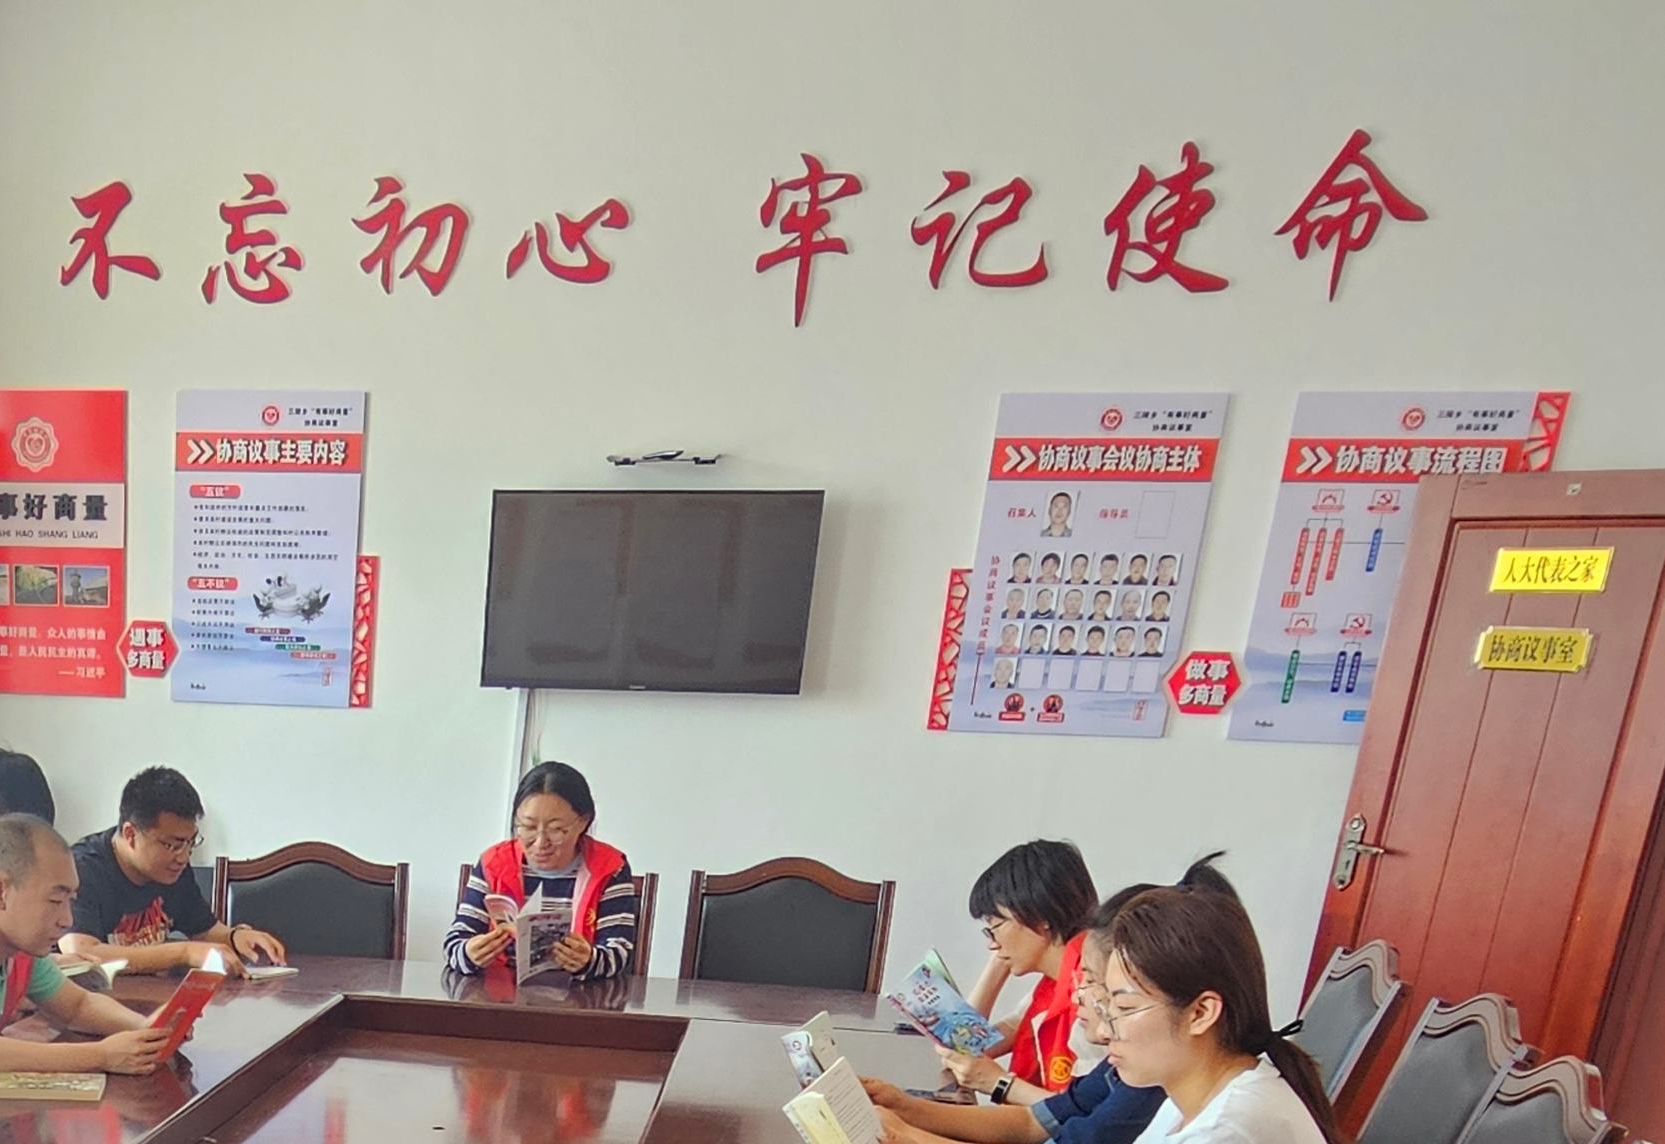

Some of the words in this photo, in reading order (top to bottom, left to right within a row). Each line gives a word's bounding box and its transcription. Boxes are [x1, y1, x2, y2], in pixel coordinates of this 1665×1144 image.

[59, 174, 631, 304] 不忘初心
[756, 130, 1427, 324] 牢记使命
[215, 438, 347, 466] 协商议事主要内容
[1038, 443, 1202, 473] 协商议事会议协商主体
[1335, 445, 1508, 475] 协商议事流程图
[16, 530, 34, 539] HAO
[38, 530, 68, 539] SHANG
[72, 531, 98, 540] LIANG
[1502, 555, 1599, 584] 人大代表之家
[1488, 634, 1578, 664] 协商议事室
[1186, 659, 1231, 681] 做事
[1178, 683, 1227, 706] 多商量
